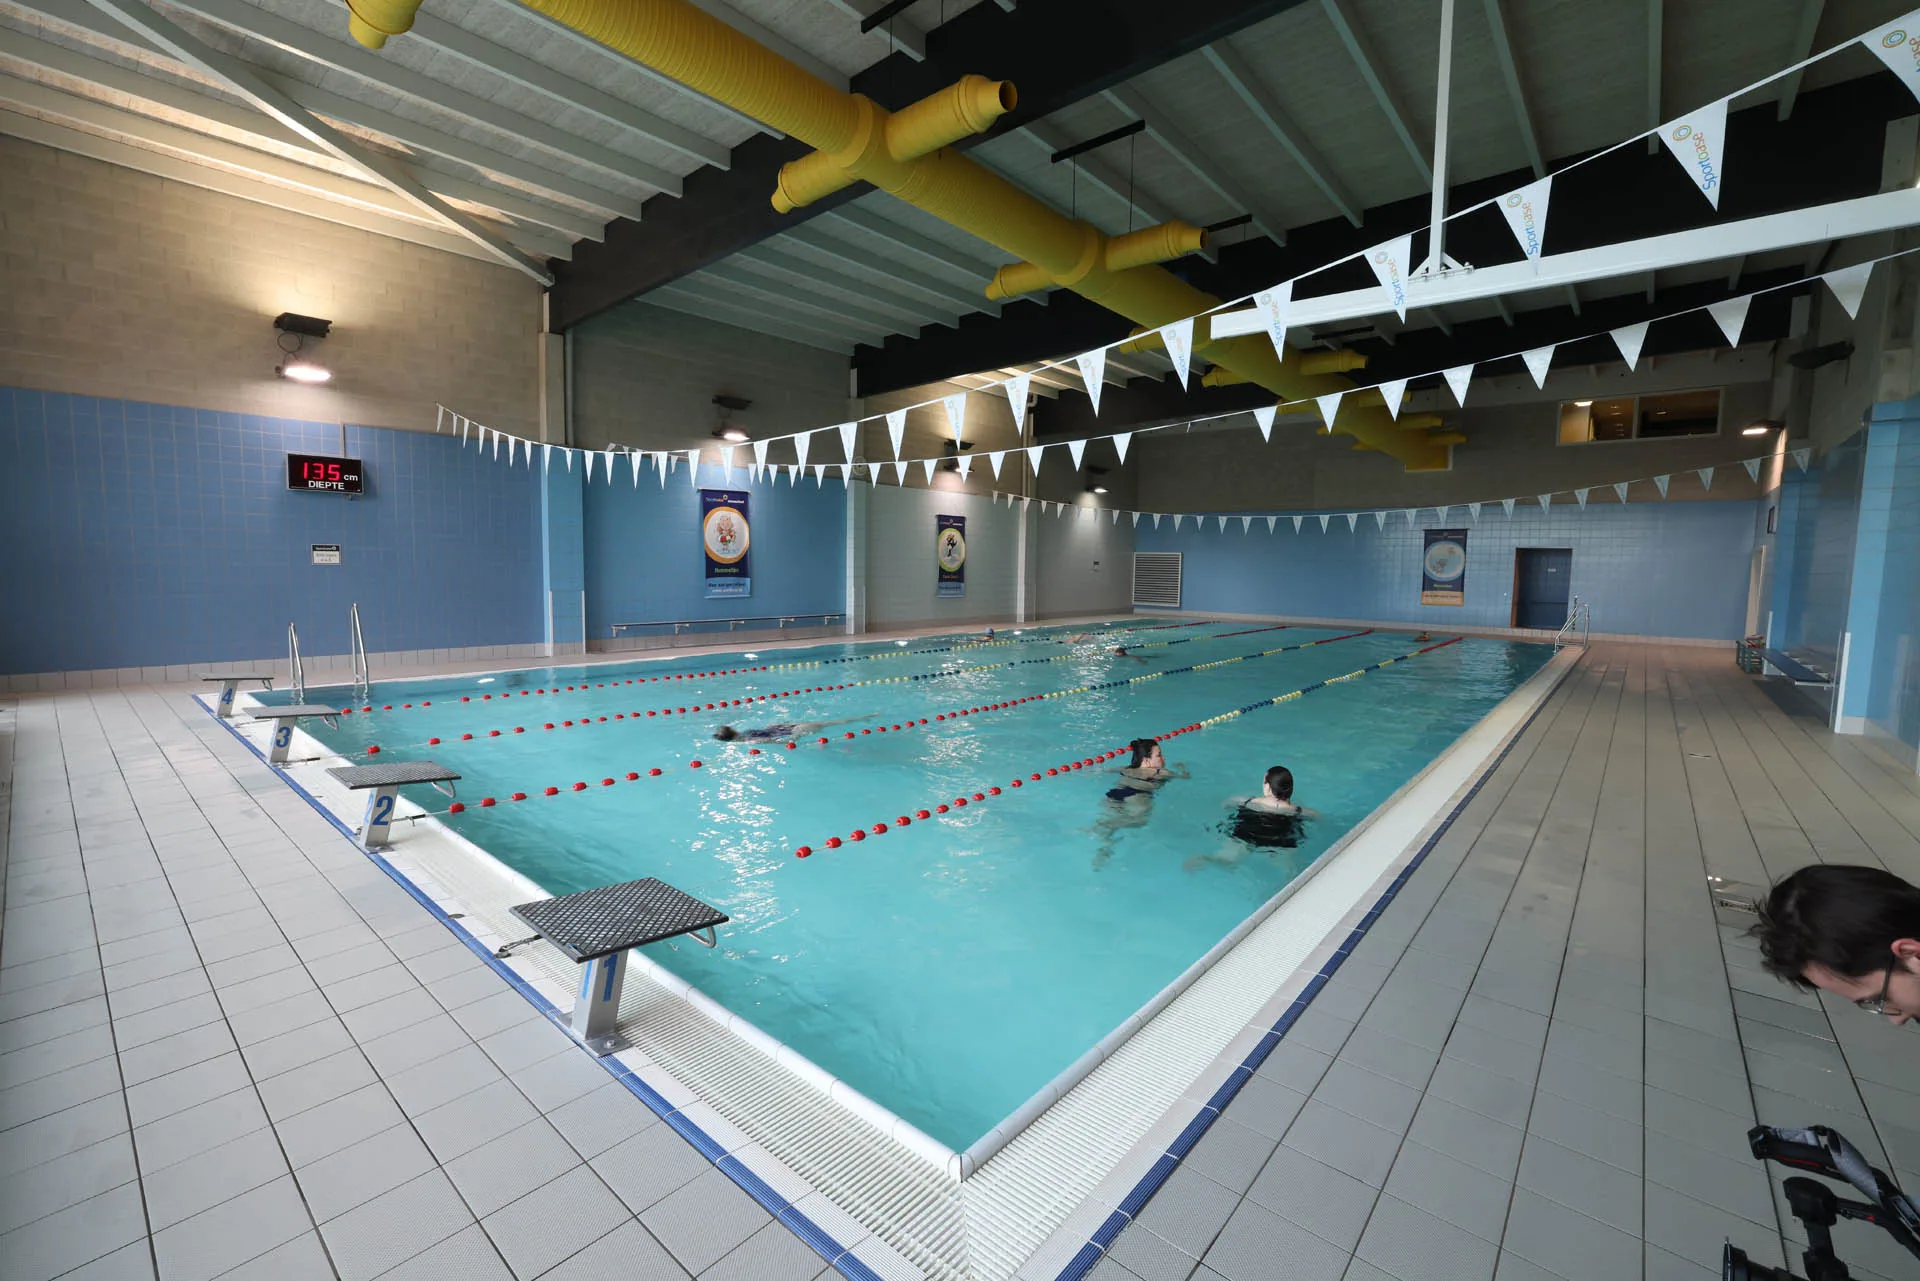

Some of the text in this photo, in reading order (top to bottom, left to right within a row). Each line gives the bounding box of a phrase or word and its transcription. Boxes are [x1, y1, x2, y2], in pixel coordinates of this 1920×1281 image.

[1693, 131, 1718, 190] Sportoase
[303, 462, 341, 481] 135
[308, 480, 345, 490] DIEPTE
[221, 687, 233, 704] 4
[276, 726, 291, 748] 3
[372, 795, 394, 825] 2
[602, 953, 618, 1002] 1
